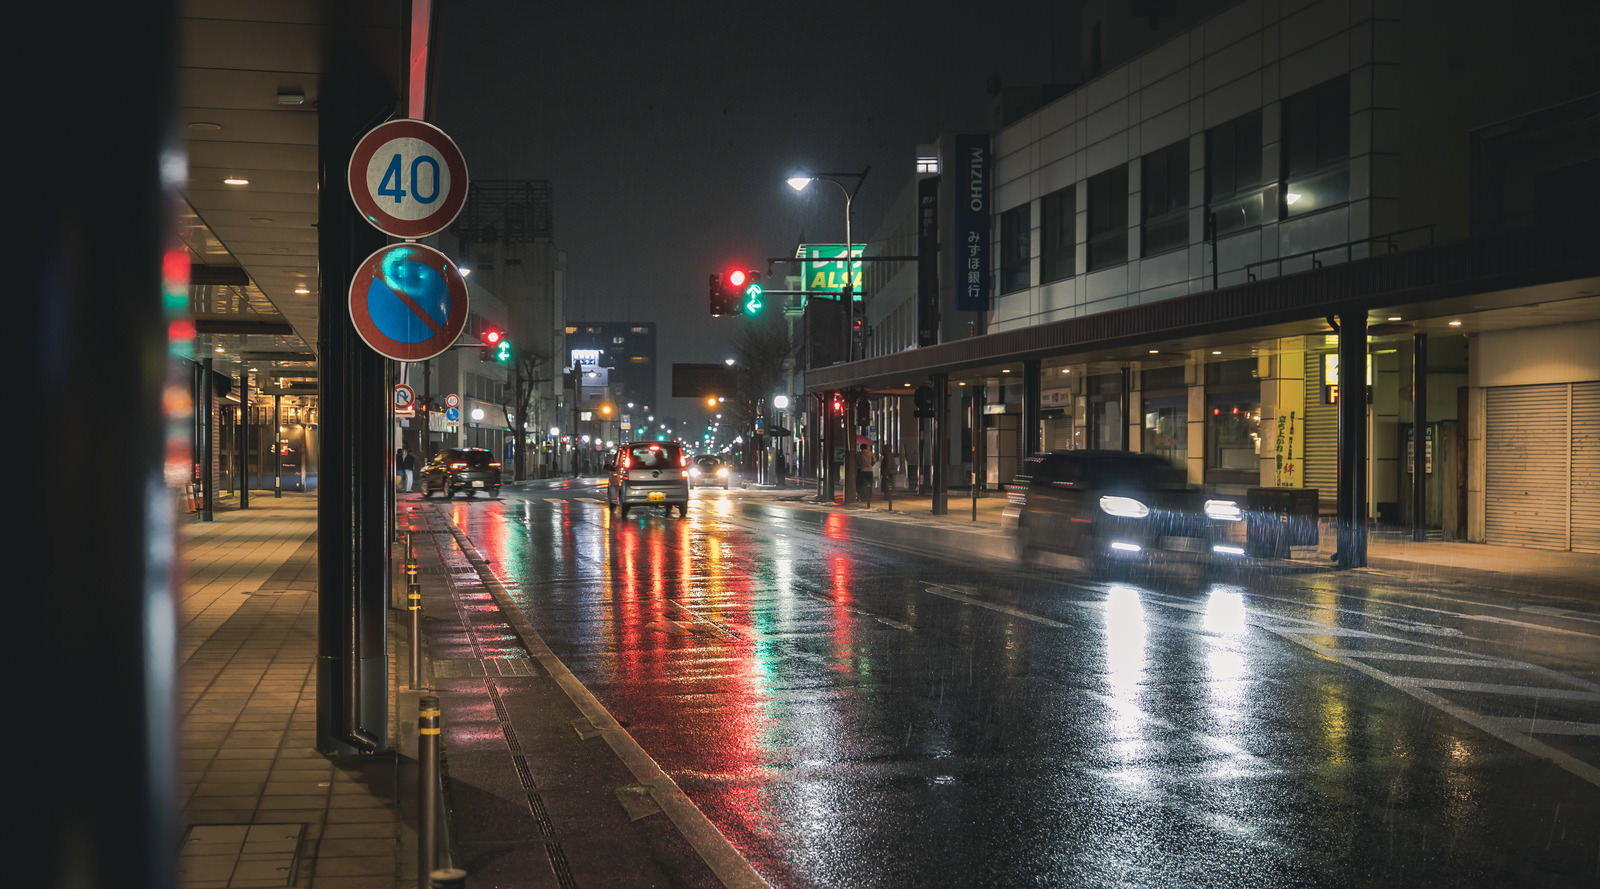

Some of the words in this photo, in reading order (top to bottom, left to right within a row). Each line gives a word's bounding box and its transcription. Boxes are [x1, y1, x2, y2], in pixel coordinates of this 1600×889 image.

[378, 153, 440, 204] 40
[970, 147, 984, 212] MIZUHO
[967, 231, 981, 298] みずほ銀行
